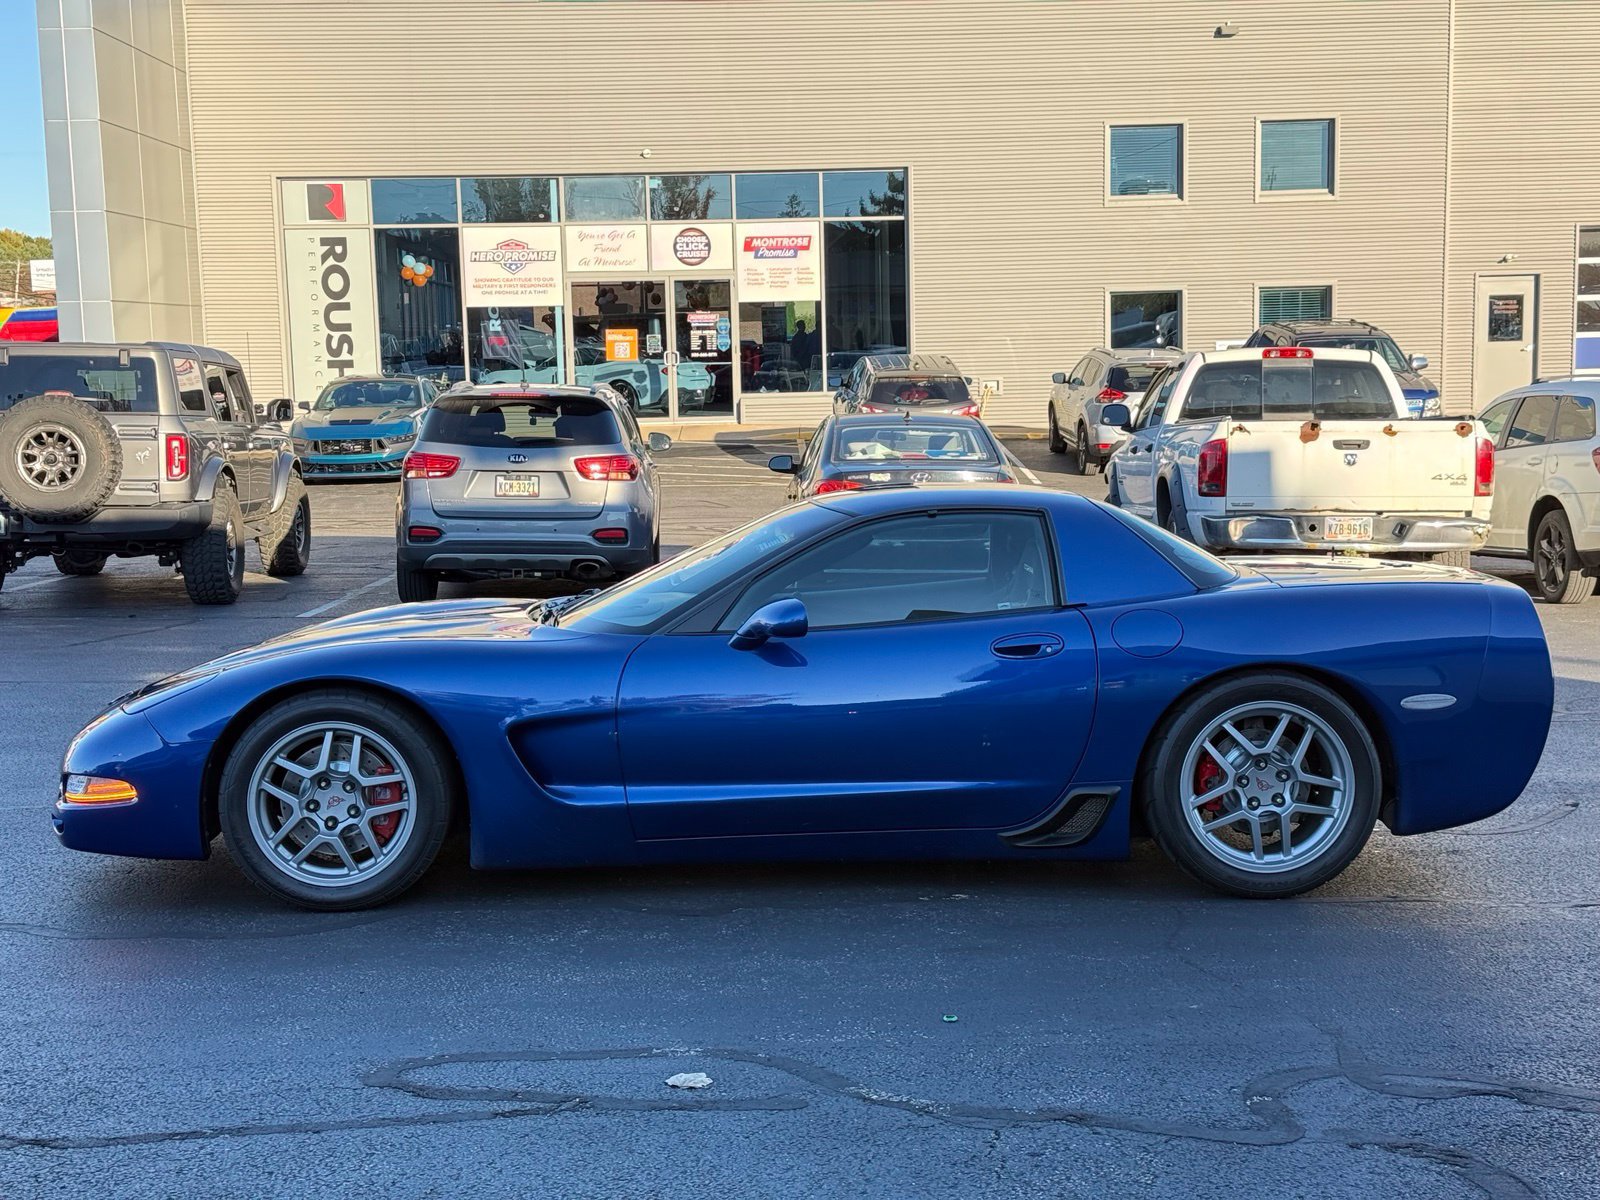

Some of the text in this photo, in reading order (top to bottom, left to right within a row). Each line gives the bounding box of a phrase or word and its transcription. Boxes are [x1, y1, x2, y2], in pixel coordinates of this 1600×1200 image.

[676, 242, 709, 251] CLICK.
[750, 237, 810, 247] MONTROSE
[593, 243, 622, 252] Friend
[757, 247, 796, 257] Promise
[470, 251, 556, 262] HERO PROMISE
[320, 237, 354, 378] ROUSH
[307, 237, 324, 391] PERFORMANCE
